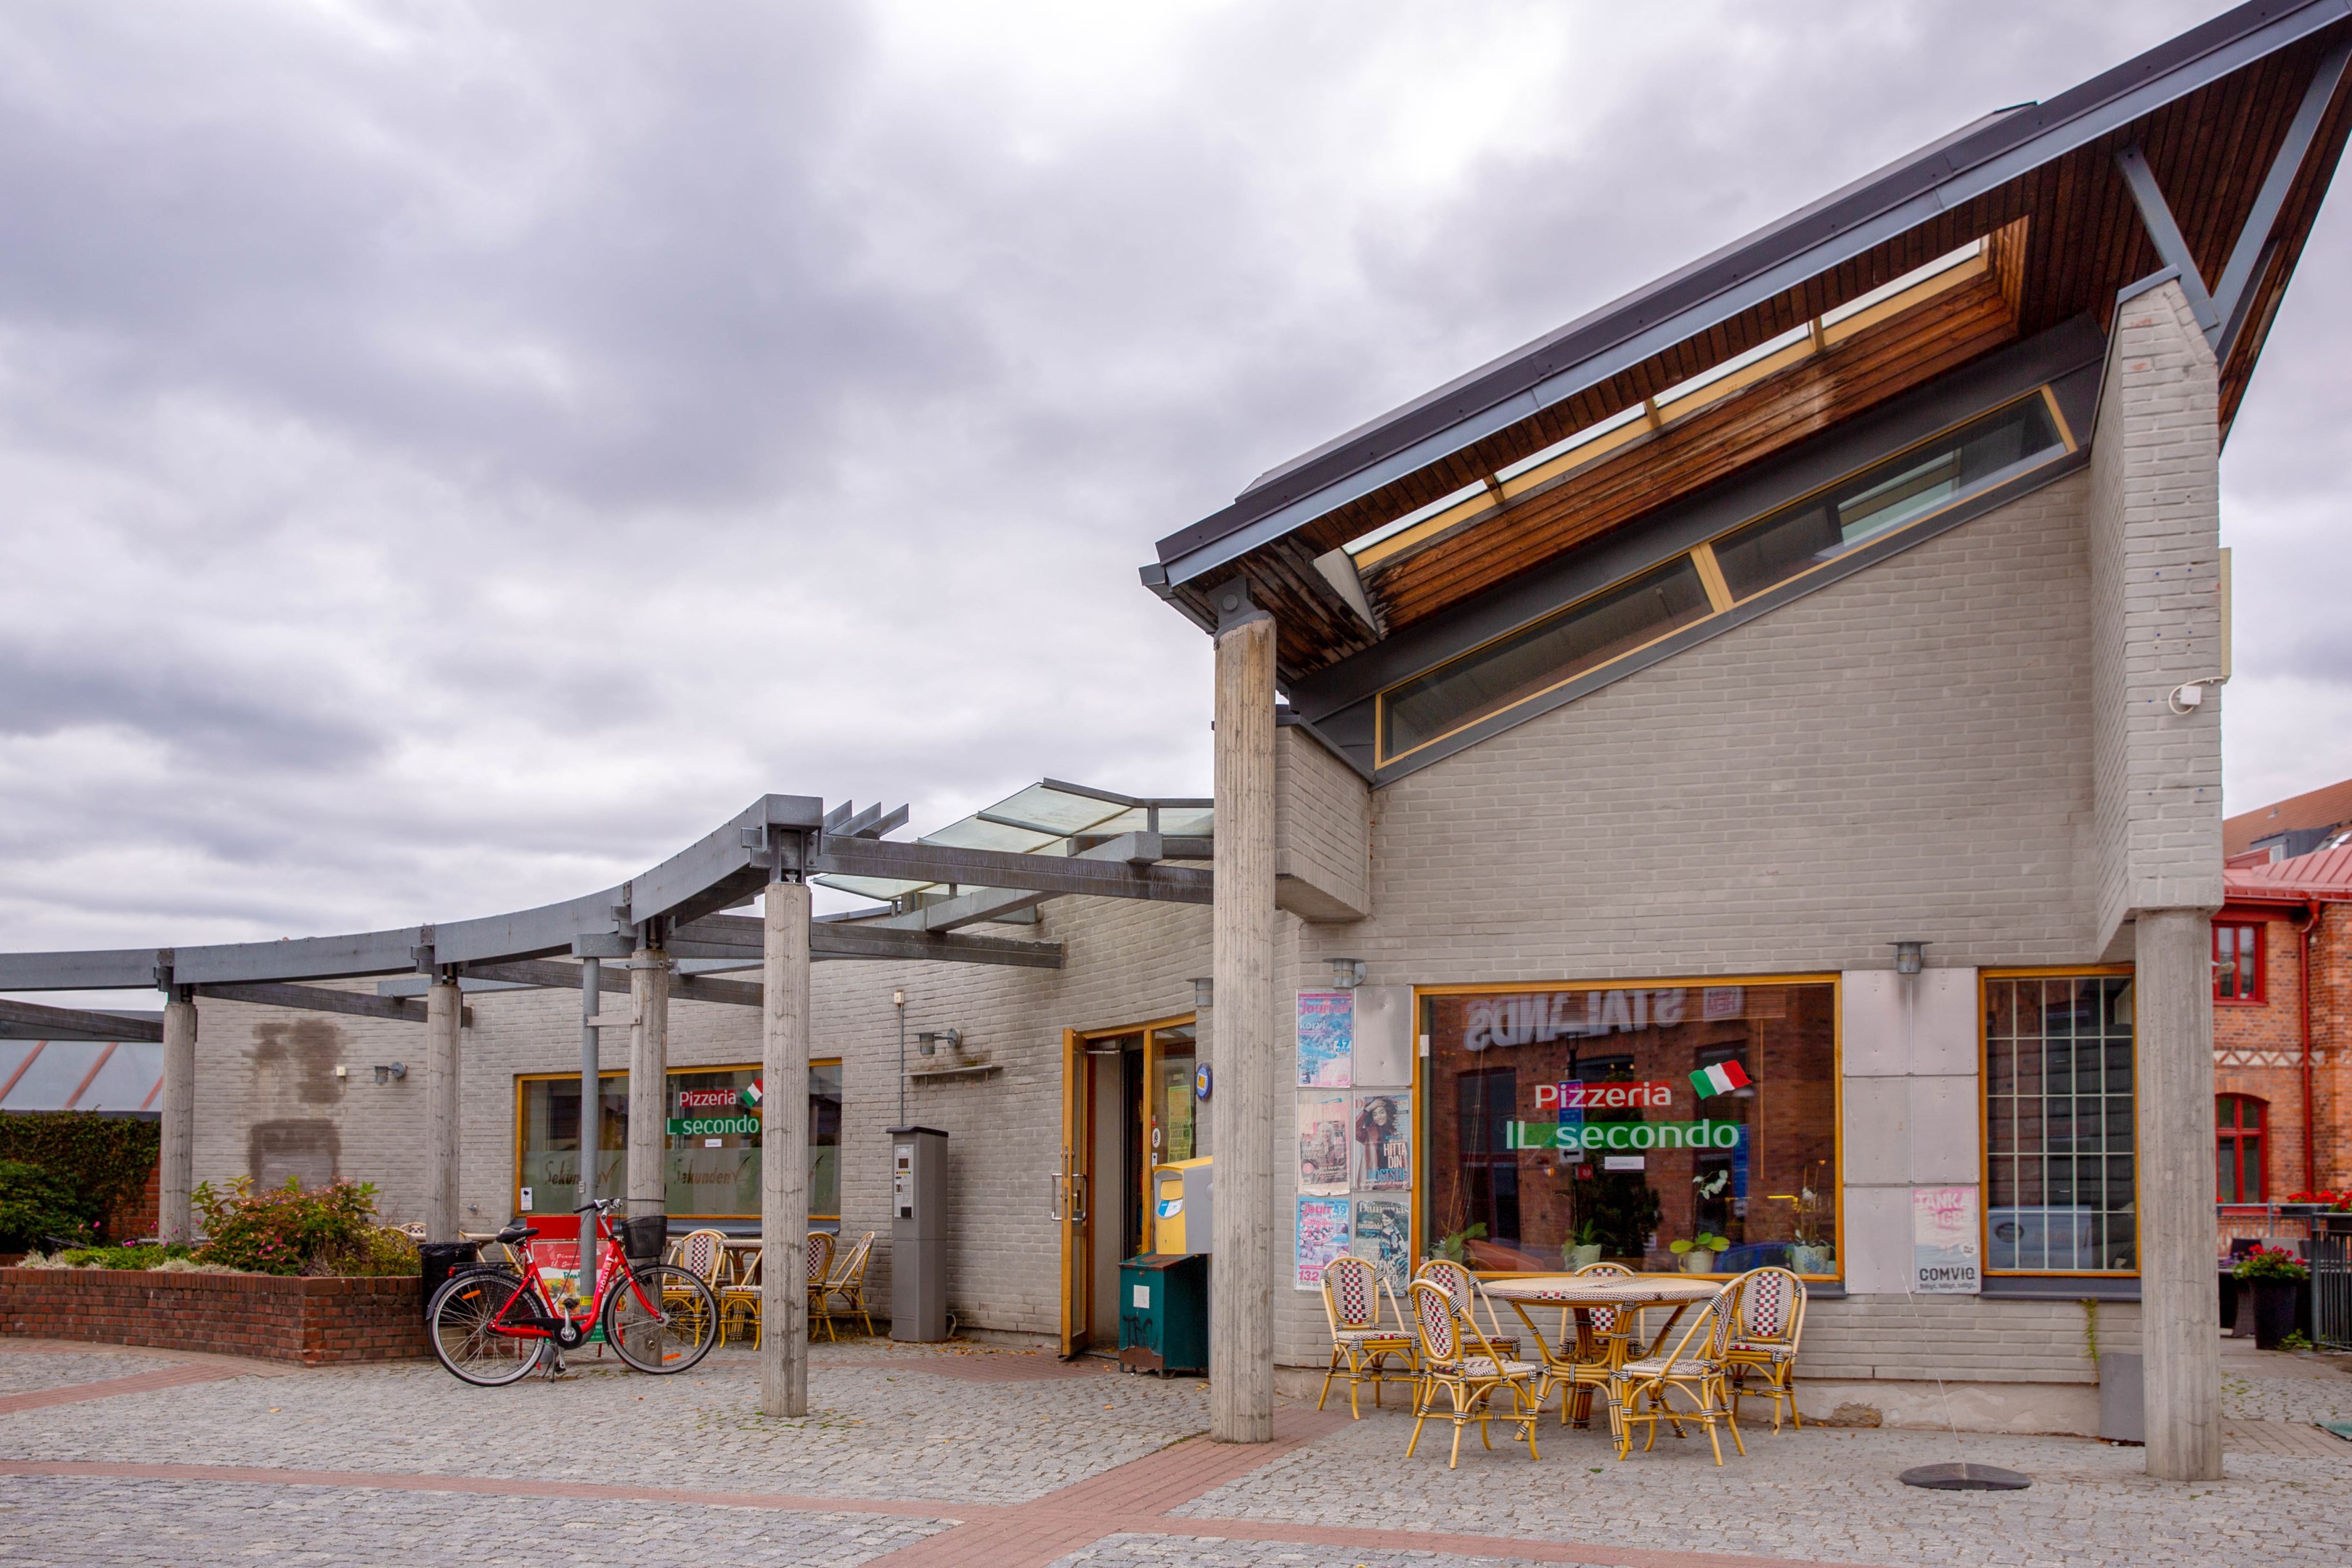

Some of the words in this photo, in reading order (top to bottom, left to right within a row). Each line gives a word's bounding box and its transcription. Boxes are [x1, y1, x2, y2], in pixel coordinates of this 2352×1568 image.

[1336, 1038, 1350, 1048] 47
[679, 1090, 736, 1107] Pizzeria
[1535, 1081, 1672, 1108] Pizzeria
[666, 1117, 677, 1135] L
[682, 1114, 759, 1135] secondo
[1556, 1119, 1740, 1150] secondo
[1384, 1142, 1408, 1156] HITTA
[1388, 1155, 1402, 1169] DIN
[1333, 1205, 1347, 1214] 49
[1299, 1270, 1319, 1281] 132
[1919, 1267, 1975, 1281] COMVIQ
